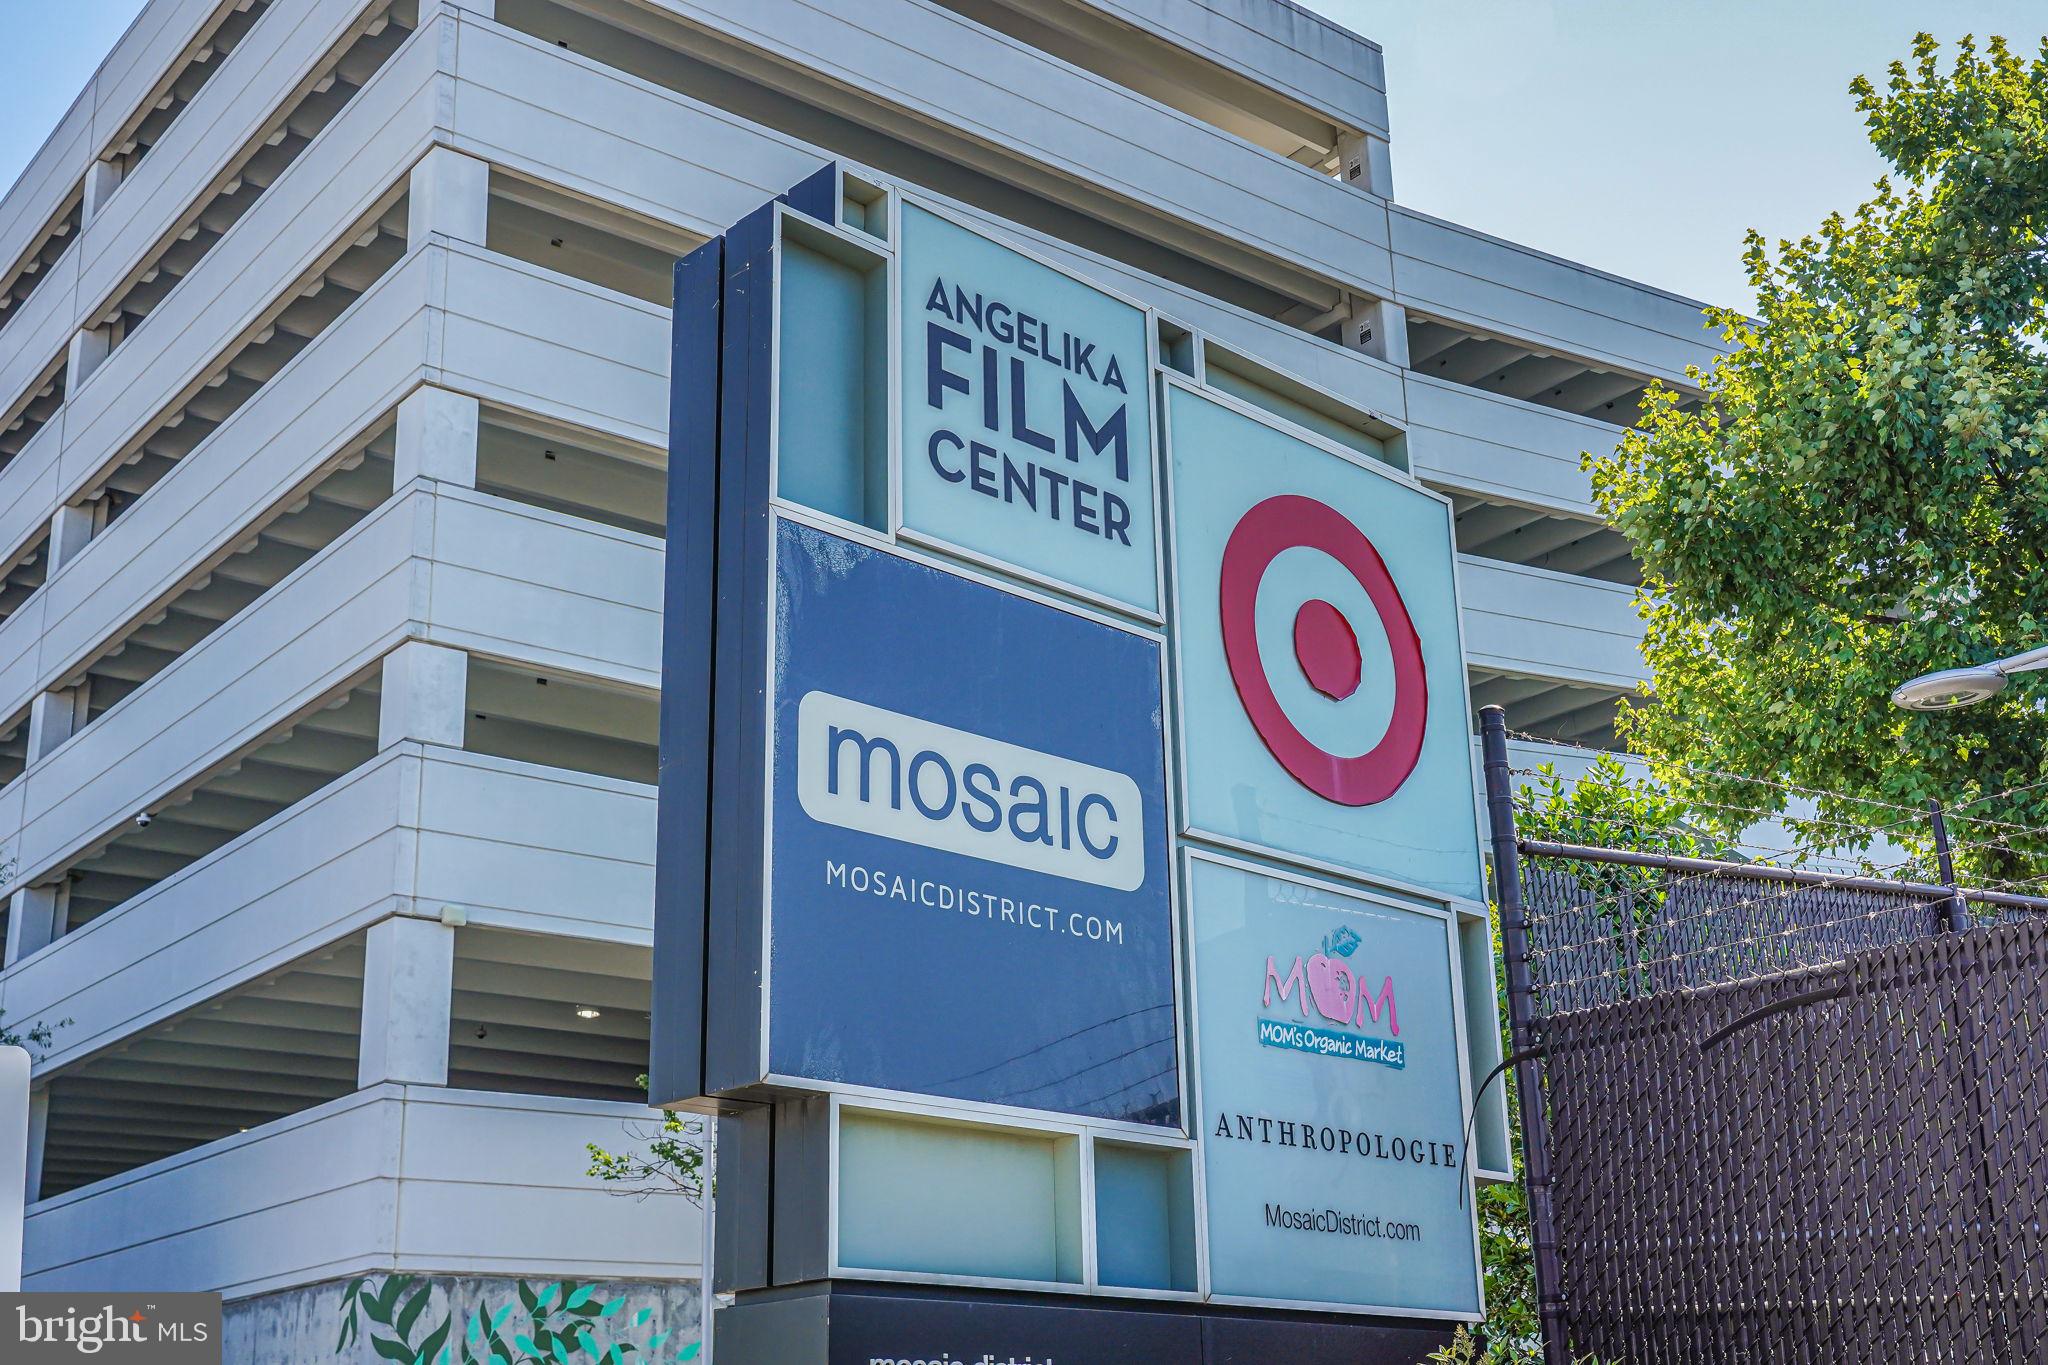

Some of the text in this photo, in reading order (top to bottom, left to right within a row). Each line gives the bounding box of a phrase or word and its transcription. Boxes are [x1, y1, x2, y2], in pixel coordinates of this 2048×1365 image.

[925, 276, 1128, 395] ANGELIKA
[927, 320, 1129, 483] FILM
[928, 429, 1132, 547] CENTER
[827, 725, 1119, 860] mosaic
[826, 860, 1123, 945] MOSAICDISTRICT.COM
[1260, 1022, 1403, 1064] MOM's Organic Market
[1215, 1112, 1457, 1168] ANTHROPOLOGIE
[1265, 1203, 1422, 1242] MosaicDistrict.com
